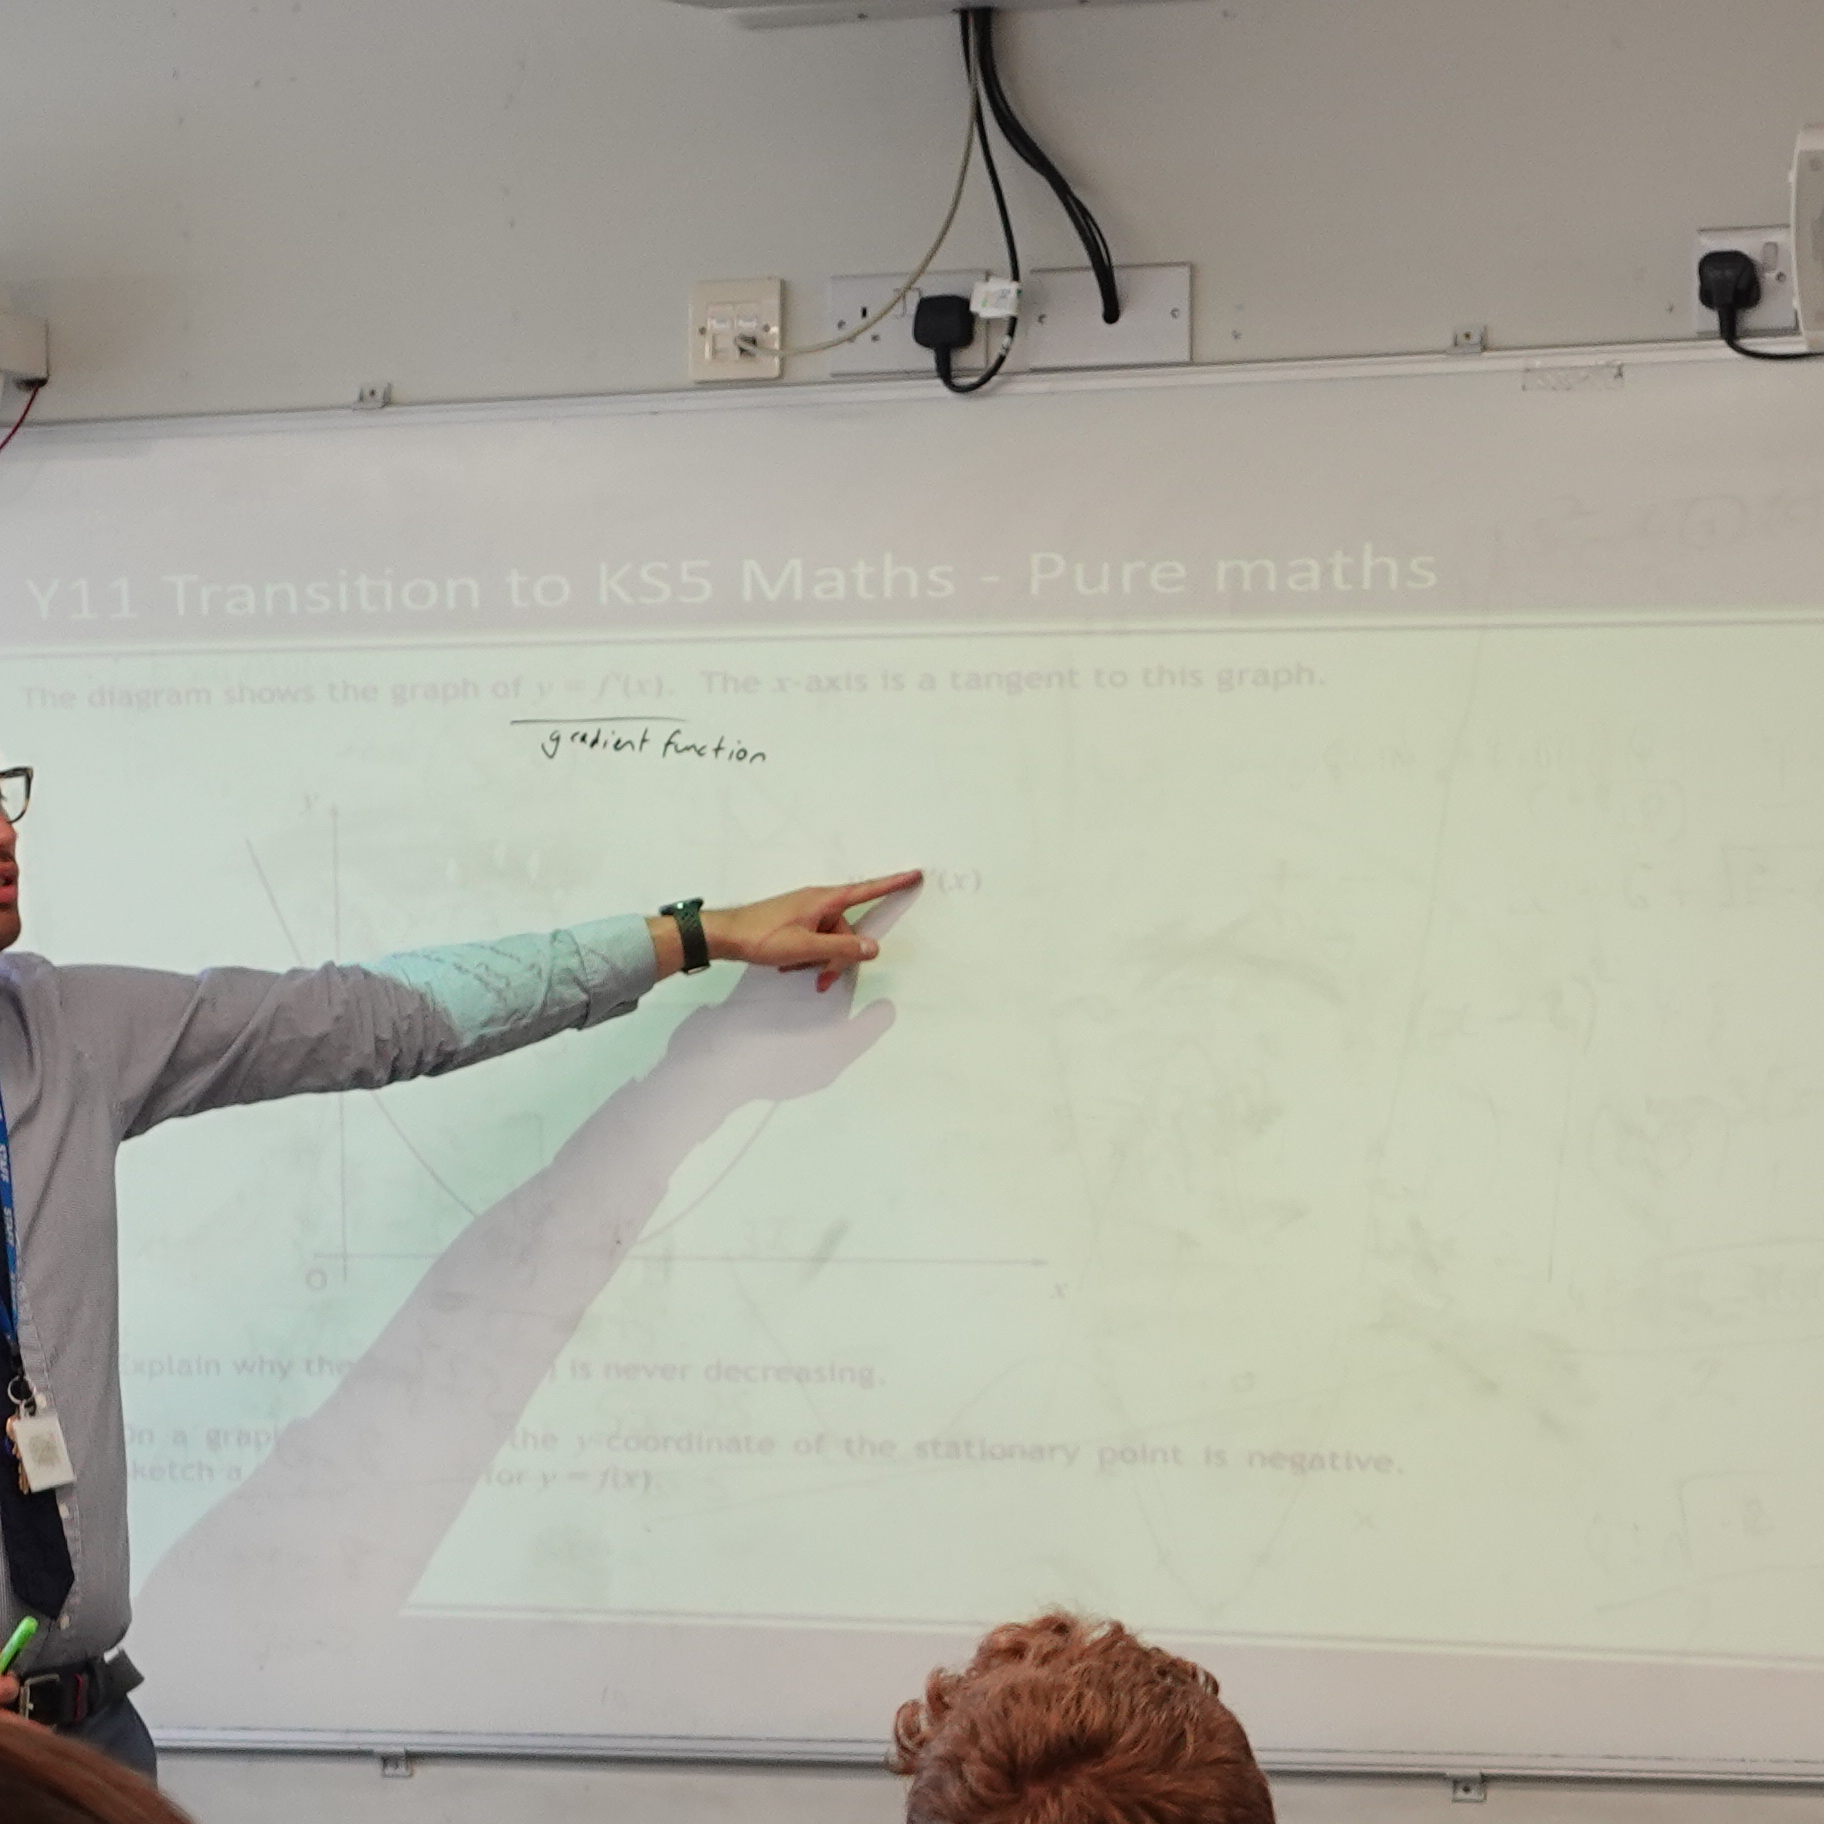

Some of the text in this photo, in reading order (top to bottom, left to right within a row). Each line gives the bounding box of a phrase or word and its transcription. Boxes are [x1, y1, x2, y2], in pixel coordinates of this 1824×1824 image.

[25, 576, 140, 621] Y11
[161, 567, 481, 618] Transition
[506, 569, 572, 609] to
[597, 560, 714, 606] KS5
[741, 551, 957, 604] Maths
[1028, 550, 1189, 597] Pure
[1215, 541, 1440, 594] maths
[23, 684, 78, 711] The
[86, 680, 214, 712] diagram
[222, 678, 317, 706] shows
[328, 676, 375, 704] the
[390, 675, 480, 709] graph
[490, 672, 526, 700] of
[699, 670, 762, 697] The
[769, 665, 869, 696] x-axis
[880, 667, 906, 694] is
[917, 671, 937, 694] a
[948, 664, 1081, 701] tangent
[1092, 664, 1129, 691] to
[1140, 661, 1205, 691] this
[1215, 661, 1329, 700] graph.
[662, 728, 768, 766] function
[232, 1354, 294, 1383] why
[304, 1354, 355, 1378] the
[570, 1358, 888, 1390] is never decreasing.
[128, 1459, 215, 1484] ketch
[792, 1431, 829, 1457] of
[842, 1430, 898, 1458] the
[912, 1433, 1081, 1469] stationary
[1097, 1440, 1187, 1472] point
[1202, 1441, 1229, 1468] is
[1244, 1445, 1407, 1478] negative.
